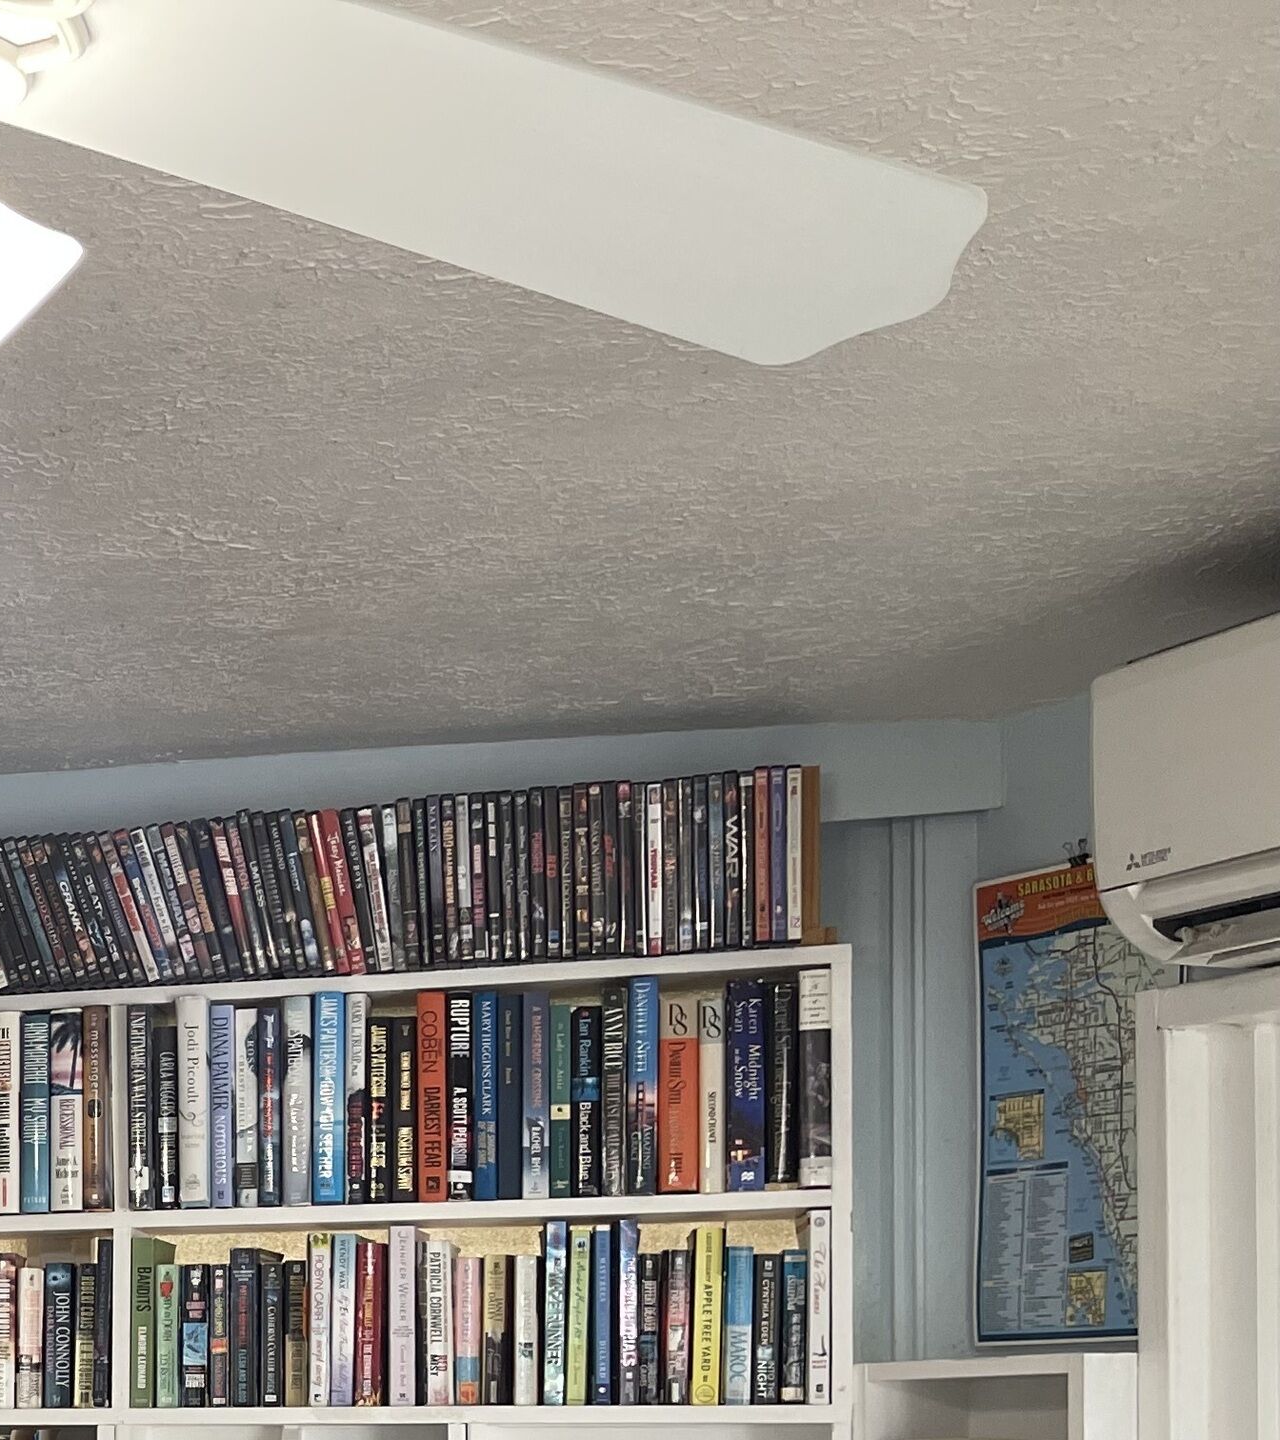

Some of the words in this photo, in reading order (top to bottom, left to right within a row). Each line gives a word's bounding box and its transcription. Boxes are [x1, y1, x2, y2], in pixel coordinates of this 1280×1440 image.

[725, 815, 738, 878] WAR
[1017, 873, 1072, 897] SARASOTA
[59, 881, 82, 932] CRANK
[450, 999, 470, 1059] RUPTURE
[579, 1019, 589, 1034] Ian
[735, 1001, 748, 1032] Swan
[748, 998, 762, 1034] Karen
[184, 1023, 199, 1047] Jodi
[421, 1011, 439, 1073] COBEN
[579, 1038, 589, 1076] Rankin
[748, 1044, 762, 1101] Midnight
[186, 1055, 199, 1104] Picoult
[735, 1066, 748, 1097] Snow
[425, 1086, 441, 1135] DARKEST
[580, 1102, 591, 1129] Black
[426, 1138, 442, 1168] FEAR
[314, 1254, 324, 1288] ROBYN
[339, 1269, 347, 1290] WAX
[429, 1251, 441, 1294] PATRICIA
[137, 1266, 152, 1312] BANDITS
[314, 1292, 324, 1321] CARR
[703, 1280, 713, 1315] APPLE
[53, 1292, 70, 1323] JOHN
[429, 1298, 442, 1345] CORNWELL
[703, 1317, 712, 1342] TREE
[55, 1327, 71, 1388] CONNOLLY
[702, 1345, 712, 1373] YARD
[757, 1361, 767, 1399] NIGHT
